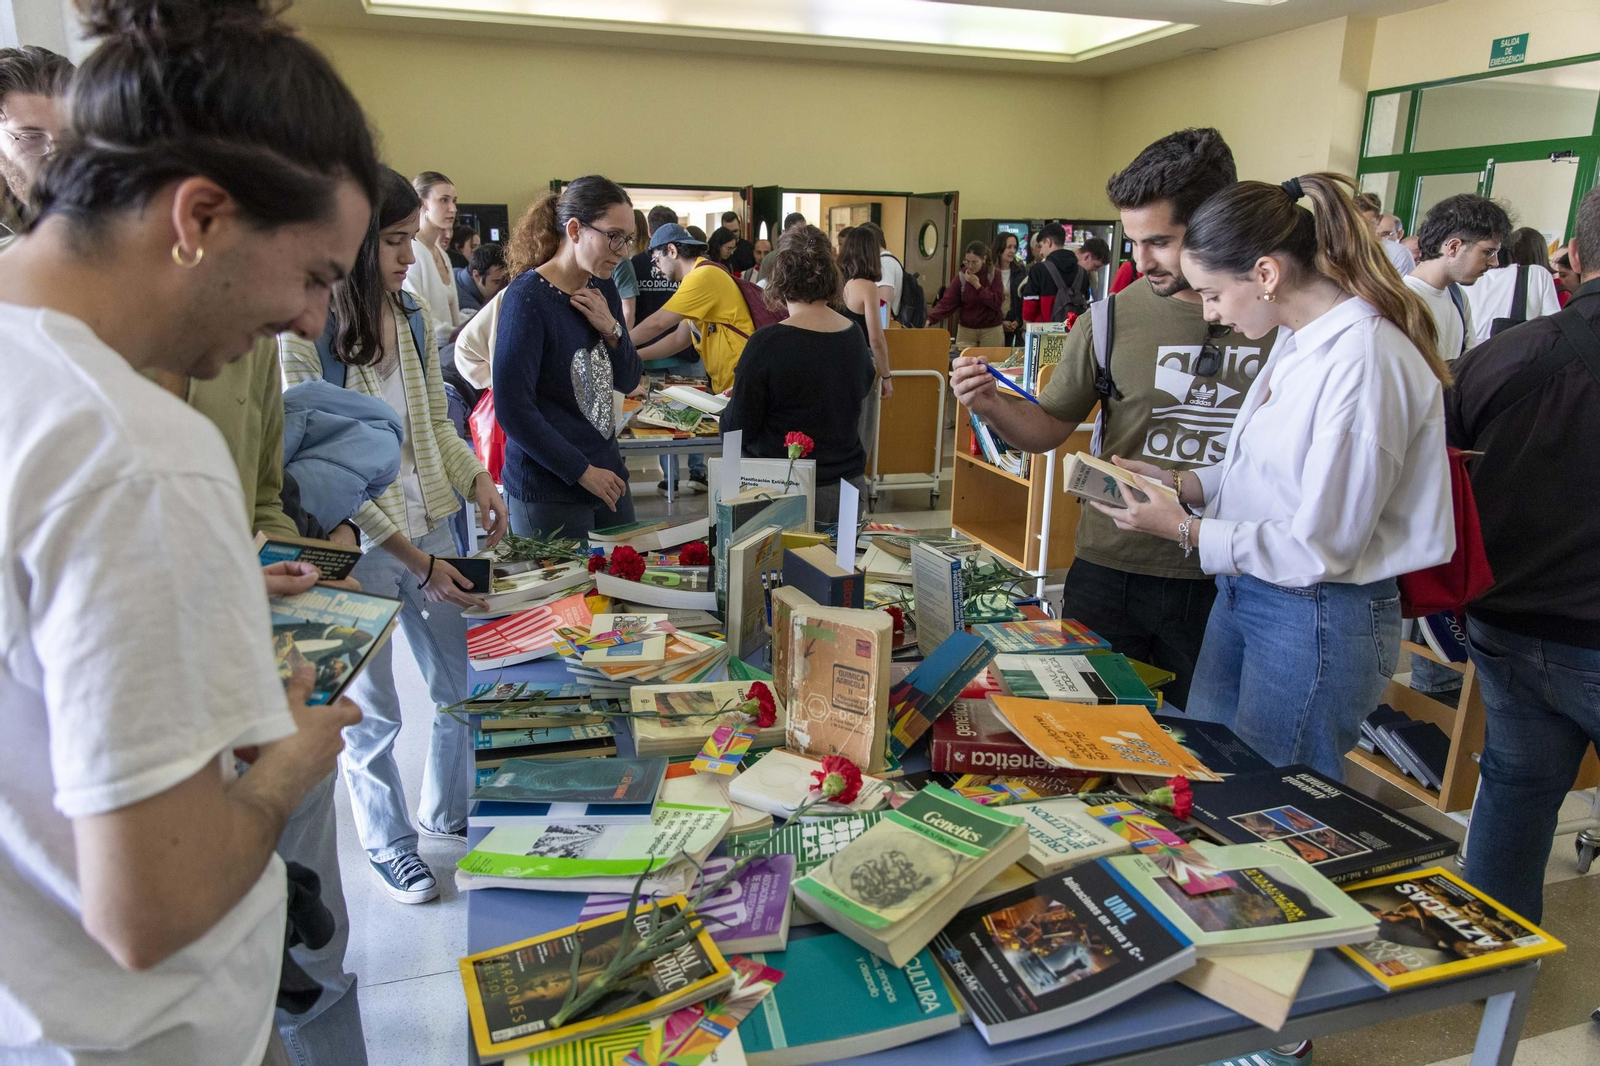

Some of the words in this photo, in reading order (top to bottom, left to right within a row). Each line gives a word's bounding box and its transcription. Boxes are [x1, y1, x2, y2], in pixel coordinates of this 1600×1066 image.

[1500, 37, 1520, 48] SALIDA
[1504, 46, 1513, 56] DE
[1489, 53, 1525, 67] EMERGENCIA
[836, 677, 865, 690] AGRICOLA
[838, 670, 865, 682] QUIMICA
[1045, 665, 1067, 692] MANUAL
[1033, 715, 1066, 745] informe
[1059, 730, 1073, 738] el
[1065, 746, 1081, 759] fao
[1069, 738, 1096, 760] sobre
[655, 810, 669, 826] crops
[923, 811, 983, 843] Genetics
[1027, 805, 1098, 848] EVOLUTION
[1056, 836, 1085, 850] and
[1062, 876, 1102, 917] Aplicaciones
[1097, 913, 1111, 926] en
[1106, 925, 1128, 944] Java
[1121, 941, 1133, 950] y
[1128, 946, 1145, 962] C++
[1103, 894, 1138, 925] UML
[1394, 883, 1503, 947] AZTECAS
[483, 959, 493, 976] DEL
[487, 979, 501, 998] SOL
[499, 954, 527, 1024] FARAONES
[860, 962, 879, 998] desarrollo
[875, 969, 898, 1003] principios
[904, 957, 941, 1014] CULTURA
